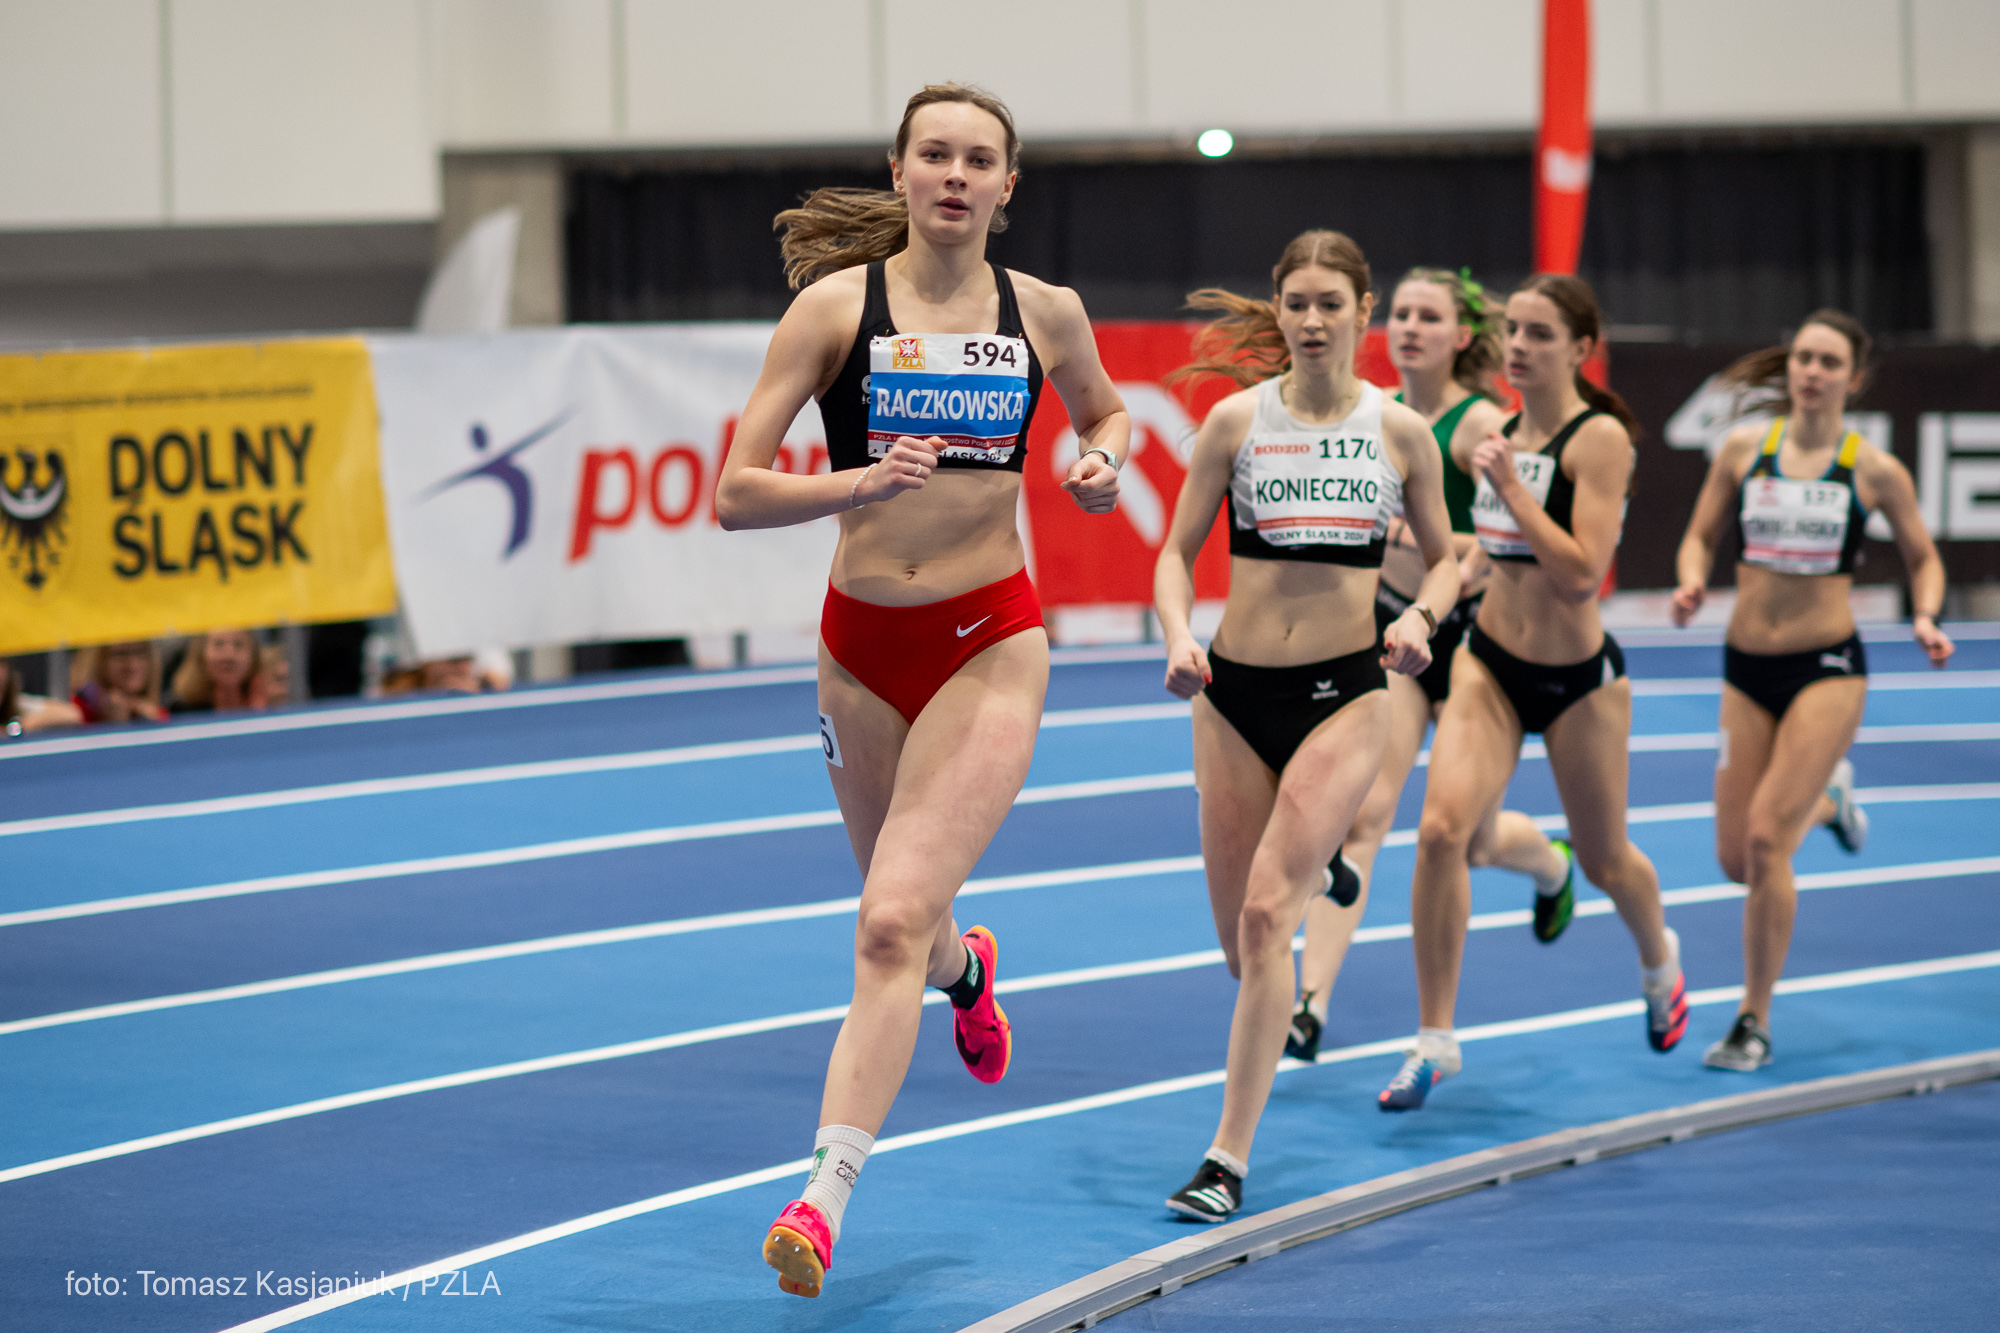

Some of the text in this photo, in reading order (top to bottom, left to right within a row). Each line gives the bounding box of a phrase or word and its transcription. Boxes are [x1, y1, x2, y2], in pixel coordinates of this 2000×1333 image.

[894, 357, 924, 368] PZLA
[963, 341, 1017, 368] 594
[875, 387, 1024, 421] RACZKOWSKA
[108, 421, 316, 502] DOLNY
[1318, 438, 1378, 461] 1170
[1256, 478, 1378, 505] KONIECZKO
[111, 489, 312, 584] ŚLĄSK
[1268, 530, 1302, 542] DOLNY
[1305, 528, 1340, 541] ŚLĄSK
